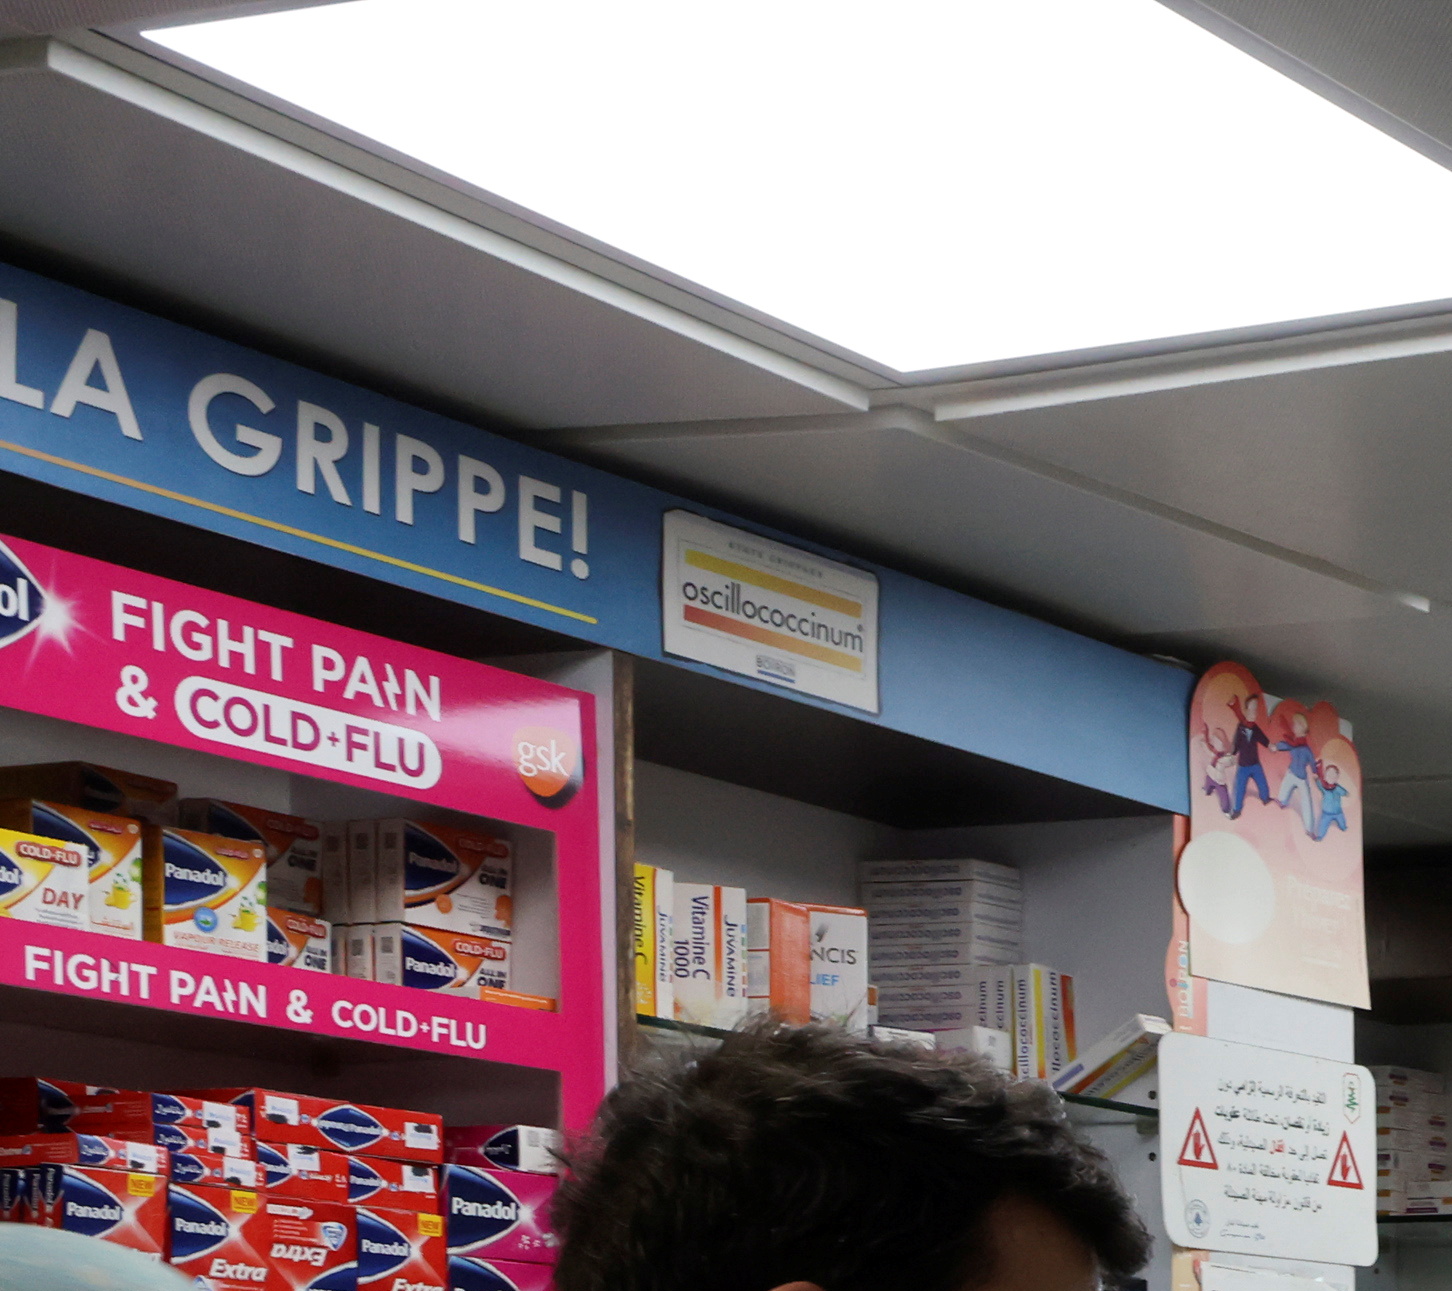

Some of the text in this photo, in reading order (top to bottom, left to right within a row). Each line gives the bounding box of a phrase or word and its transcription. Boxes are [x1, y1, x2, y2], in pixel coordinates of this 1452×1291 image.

[0, 298, 591, 581] LA GRIPPE!
[682, 581, 864, 653] oscillococcinum
[110, 590, 442, 723] FIGHT PAIN
[115, 666, 427, 779] & COLD+FLU
[515, 737, 571, 778] gsk
[164, 862, 226, 888] Panadol
[42, 887, 85, 910] DAY
[690, 895, 711, 981] Vitamine C
[405, 956, 457, 978] Panadol
[673, 939, 690, 979] 1000
[24, 945, 488, 1050] FIGHT PAIN & COLD+FLU
[66, 1201, 123, 1223] Panadol
[451, 1197, 517, 1222] Panadol
[174, 1216, 228, 1238] Panadol
[270, 1242, 329, 1267] Extra
[361, 1238, 410, 1258] Panadol
[208, 1256, 269, 1283] Extra
